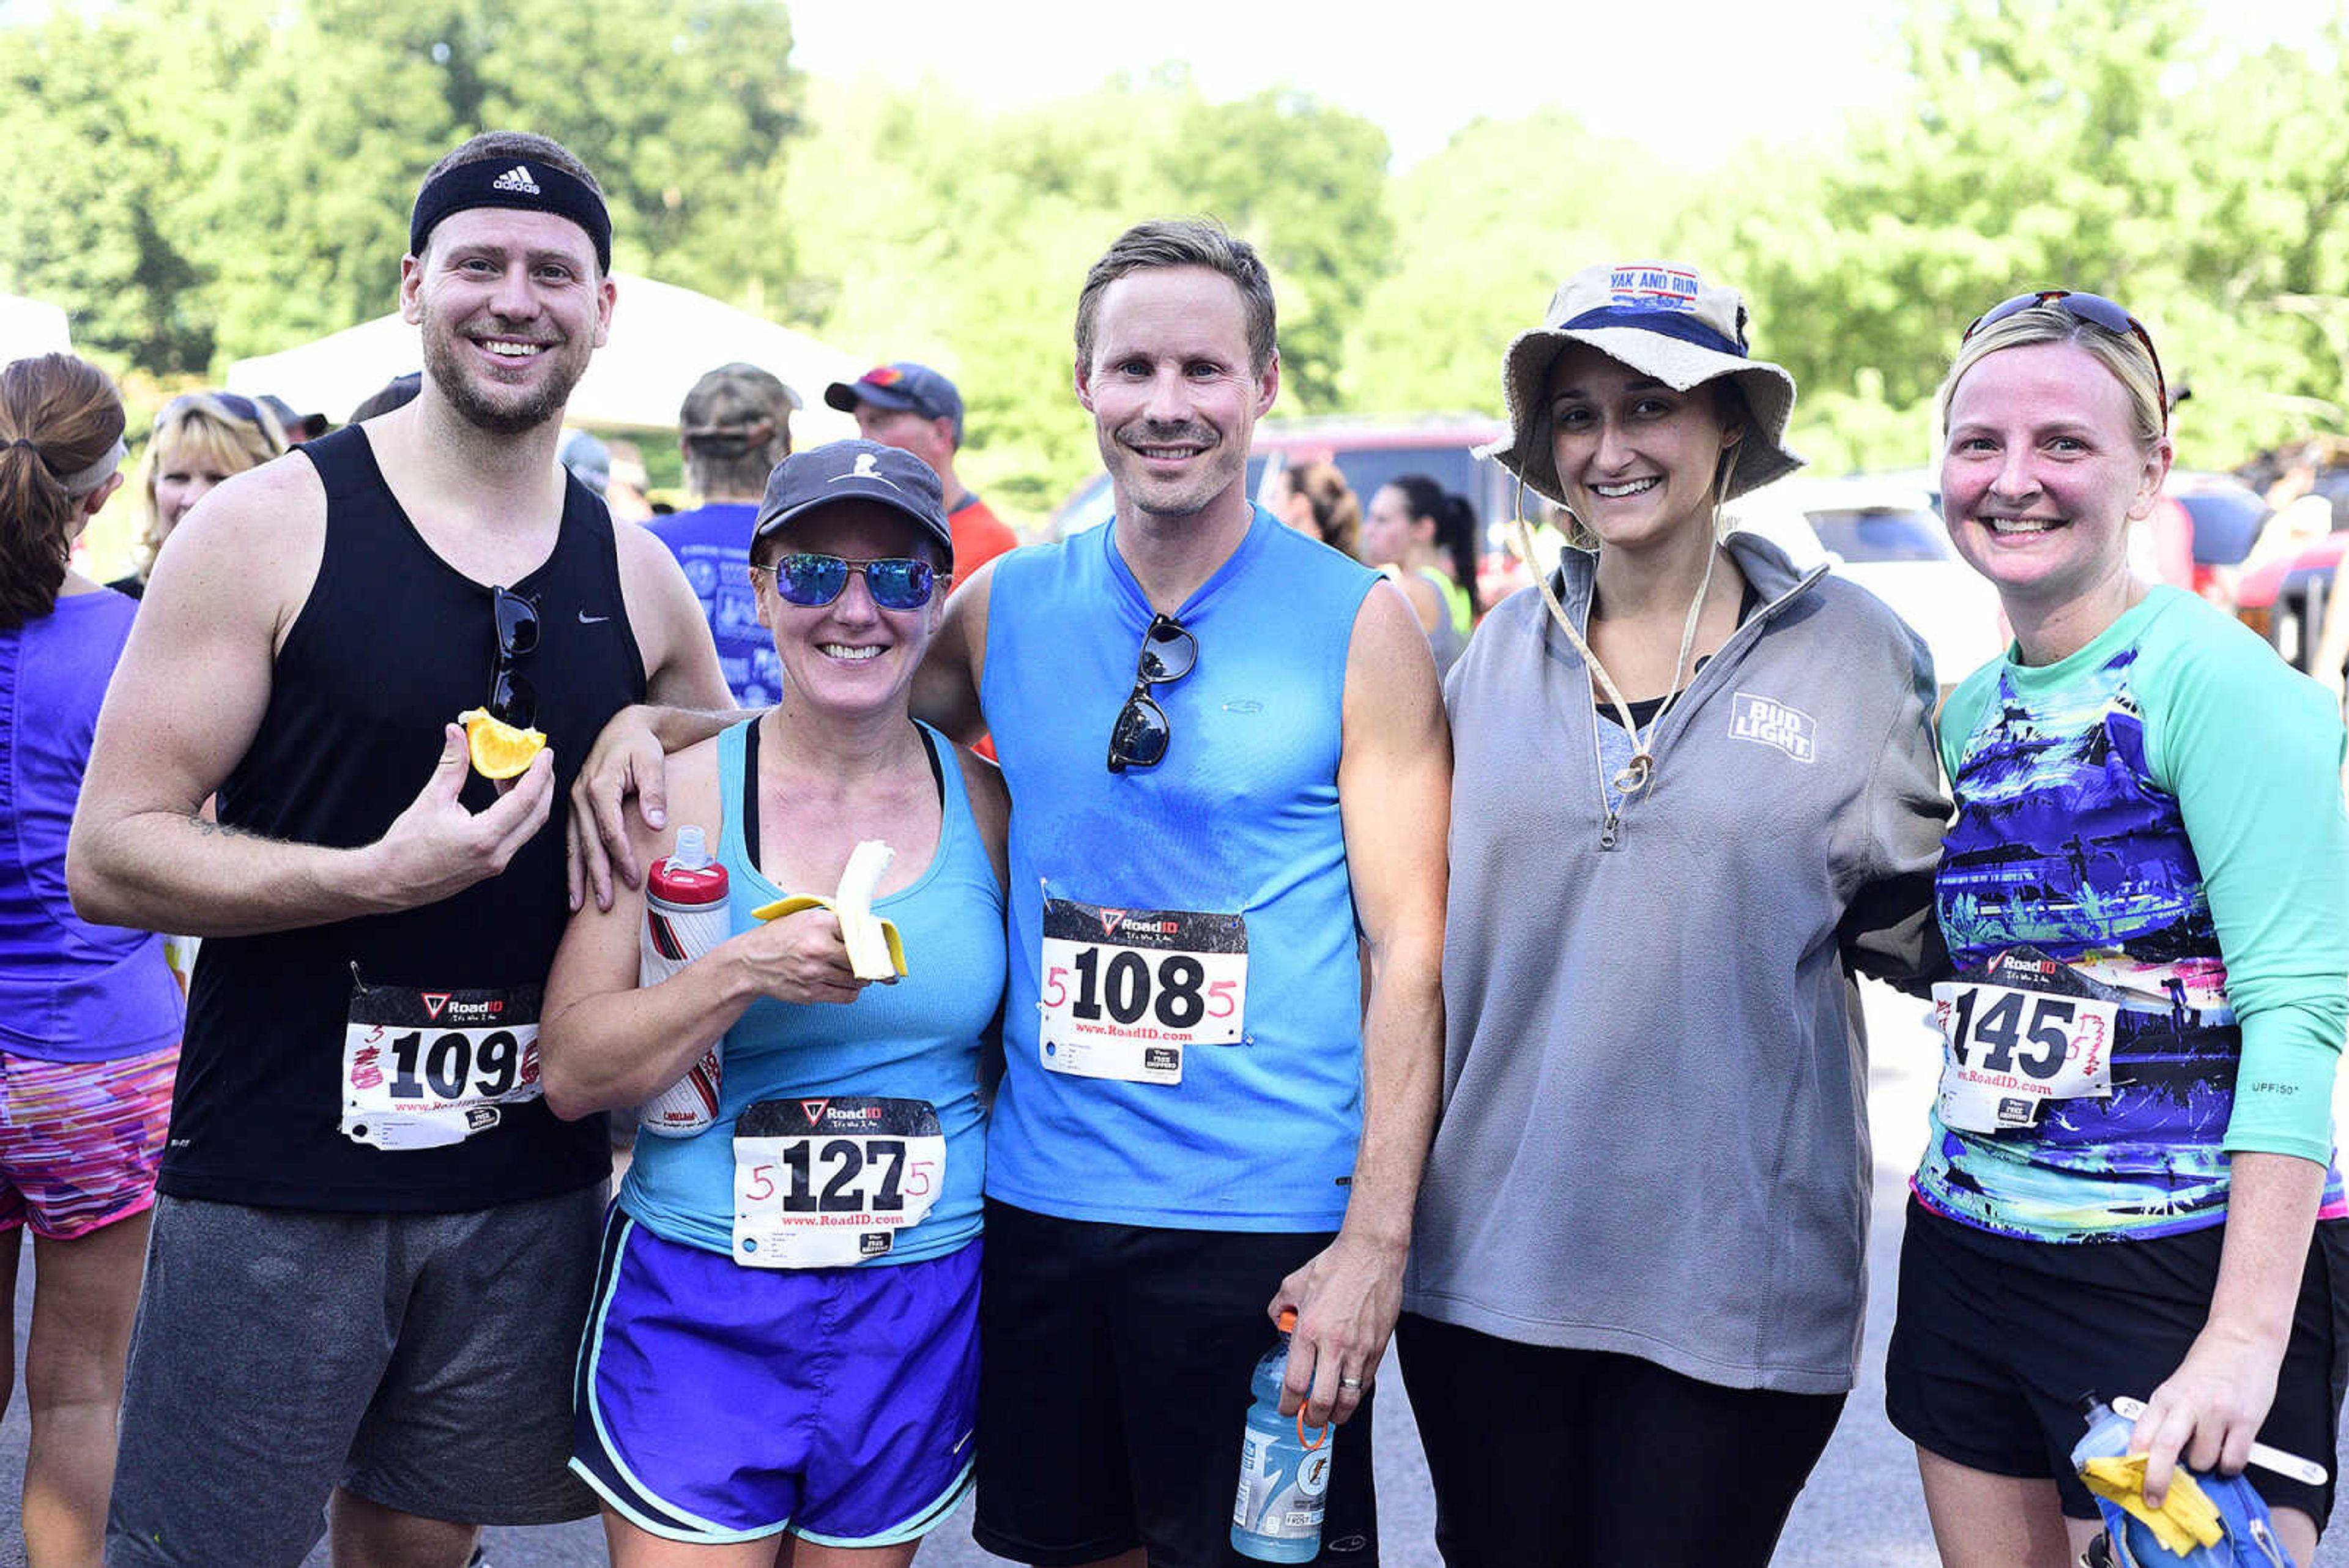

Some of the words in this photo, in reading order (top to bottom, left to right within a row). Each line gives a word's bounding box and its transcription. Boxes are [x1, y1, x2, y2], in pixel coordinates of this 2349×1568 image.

[492, 180, 540, 195] adidas
[1611, 272, 1636, 288] YAK
[1639, 272, 1668, 290] AND
[1672, 277, 1698, 295] RUN
[1750, 701, 1802, 731] BUD
[1736, 716, 1810, 756] LIGHT
[1121, 918, 1179, 934] RoadID
[2003, 955, 2057, 975] RoadID
[1043, 967, 1068, 1008] 5
[1072, 947, 1206, 1029] 108
[1206, 980, 1238, 1019] 5
[448, 1000, 503, 1013] RoadID
[1075, 1023, 1193, 1042] www.RoadID.com
[1954, 987, 2076, 1080] 145
[389, 1030, 519, 1100] 109
[826, 1106, 882, 1119] RoadID
[746, 1165, 774, 1200] 5
[782, 1139, 907, 1212] 127
[904, 1161, 935, 1196] 5
[782, 1214, 904, 1227] www.RoadID.com
